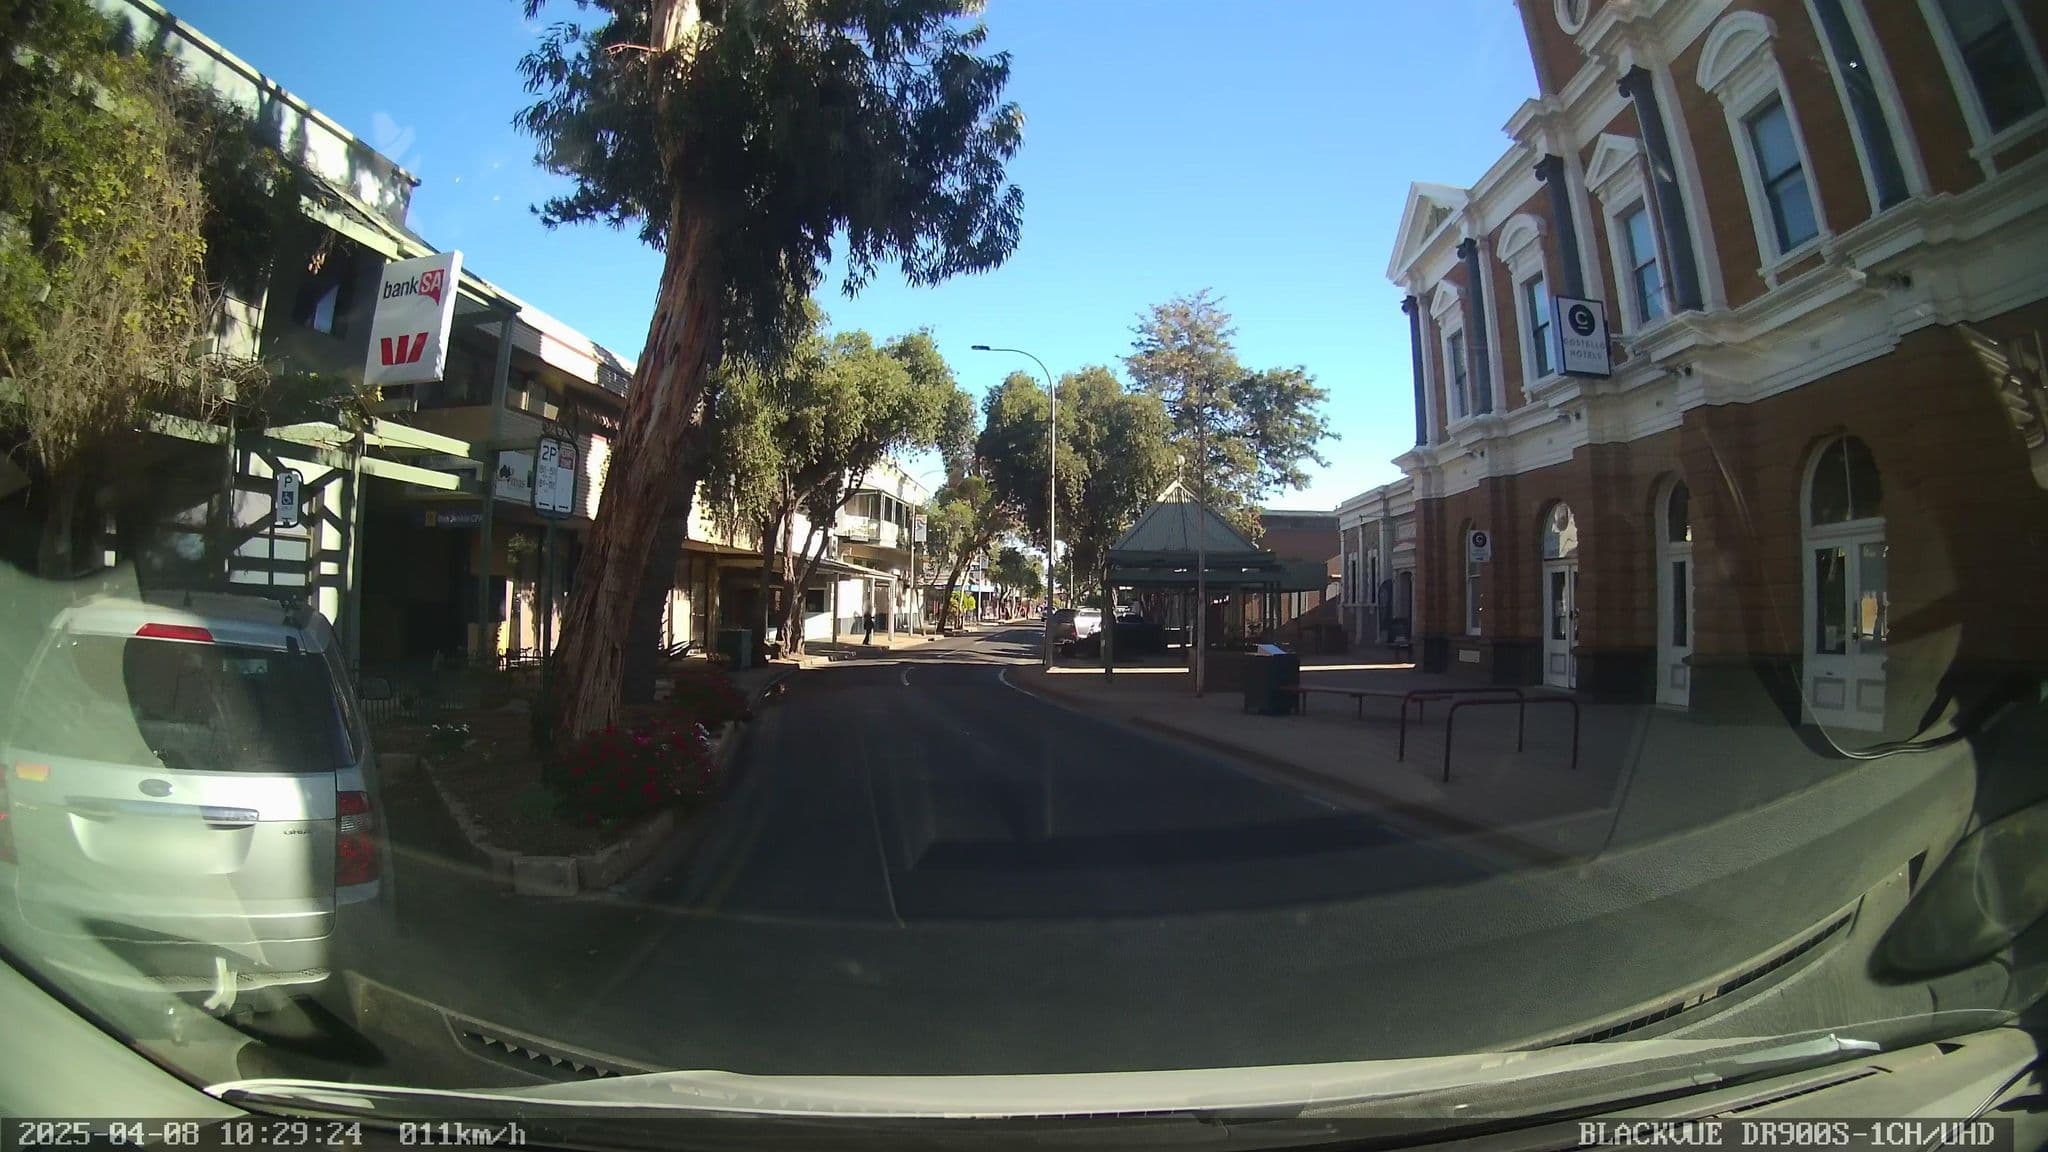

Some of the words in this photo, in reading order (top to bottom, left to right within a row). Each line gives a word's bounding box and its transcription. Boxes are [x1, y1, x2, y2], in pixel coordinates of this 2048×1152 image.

[1569, 350, 1603, 360] HOTELS
[542, 445, 558, 461] 2P
[284, 476, 293, 488] P
